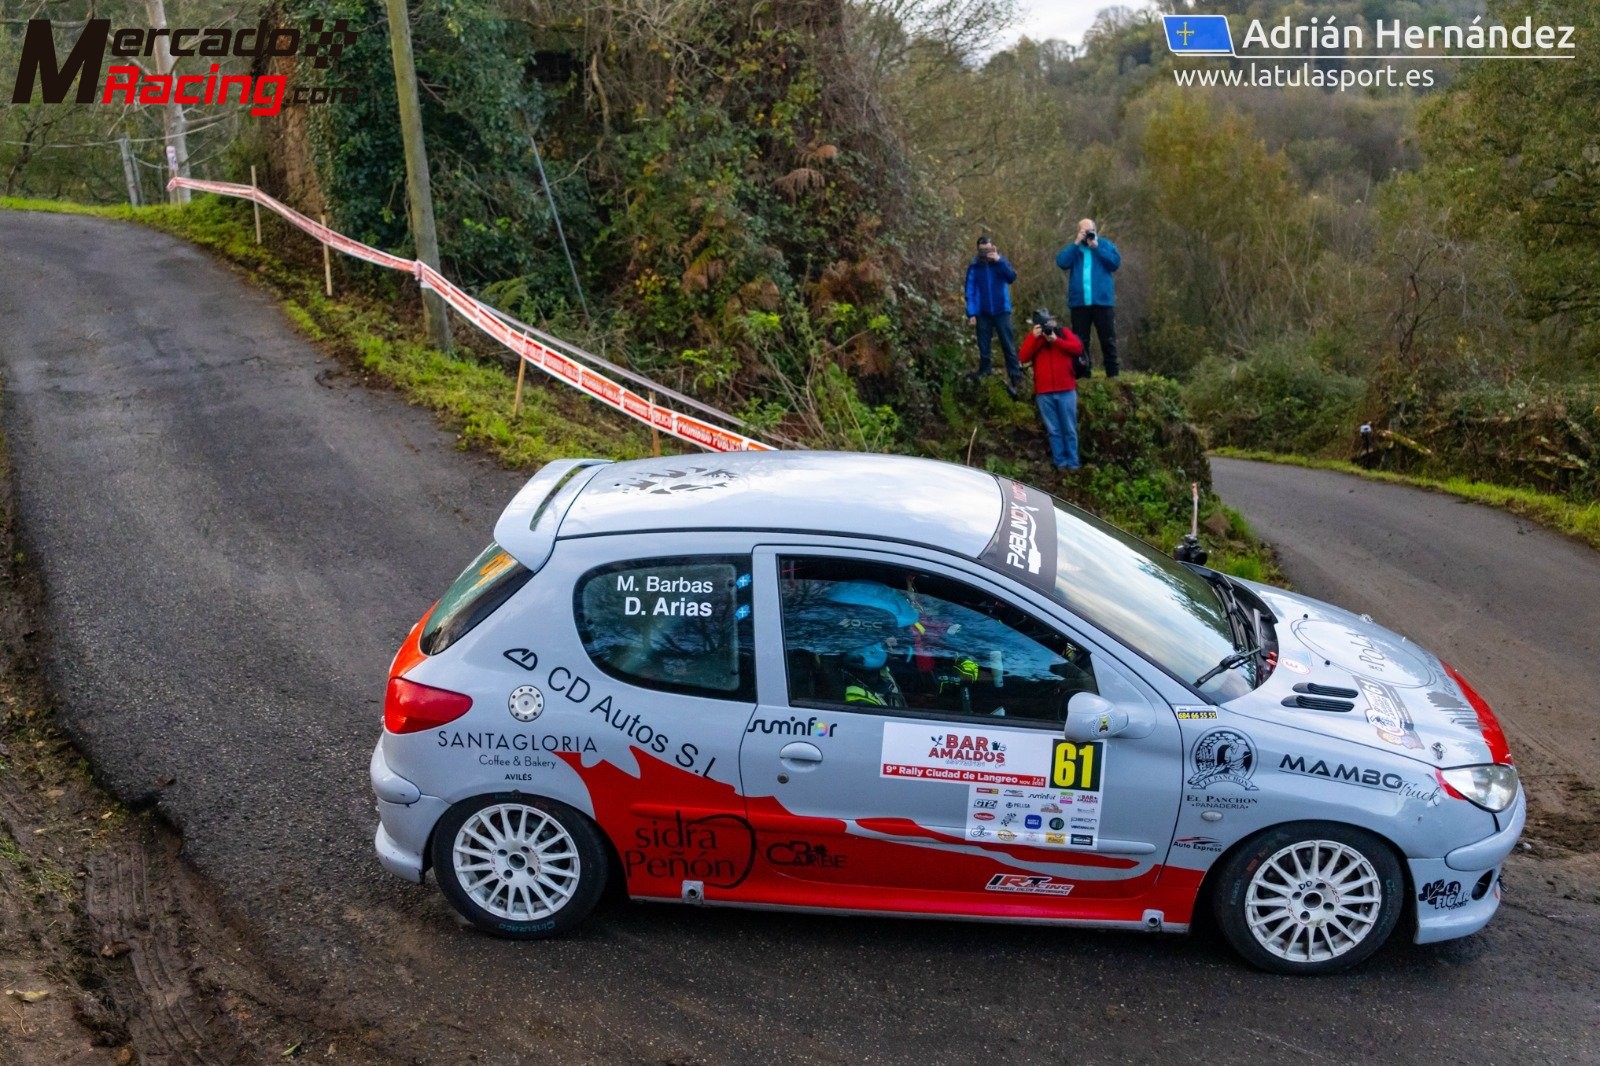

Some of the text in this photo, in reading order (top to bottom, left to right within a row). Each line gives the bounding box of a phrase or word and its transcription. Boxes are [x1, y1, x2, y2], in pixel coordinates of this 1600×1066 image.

[616, 576, 713, 593] M. Barbas
[625, 597, 713, 617] D. Arias
[547, 666, 590, 703] CD
[590, 695, 669, 753] Autos
[747, 716, 838, 738] suminfor
[438, 731, 597, 753] SANTAGLORIA
[945, 734, 989, 751] BAR
[479, 754, 557, 770] Coffee & Bakery
[928, 748, 1006, 764] AMALDOS
[1053, 742, 1094, 789] 61
[899, 767, 924, 777] Rally
[926, 769, 961, 780] Ciudad
[963, 772, 975, 780] de
[977, 772, 1018, 784] Langreo
[1279, 754, 1403, 789] MAMBO
[635, 810, 717, 849] sidra
[1173, 841, 1191, 849] Auto
[1193, 842, 1222, 852] Express
[624, 851, 735, 878] Peñón
[1446, 883, 1459, 895] LA
